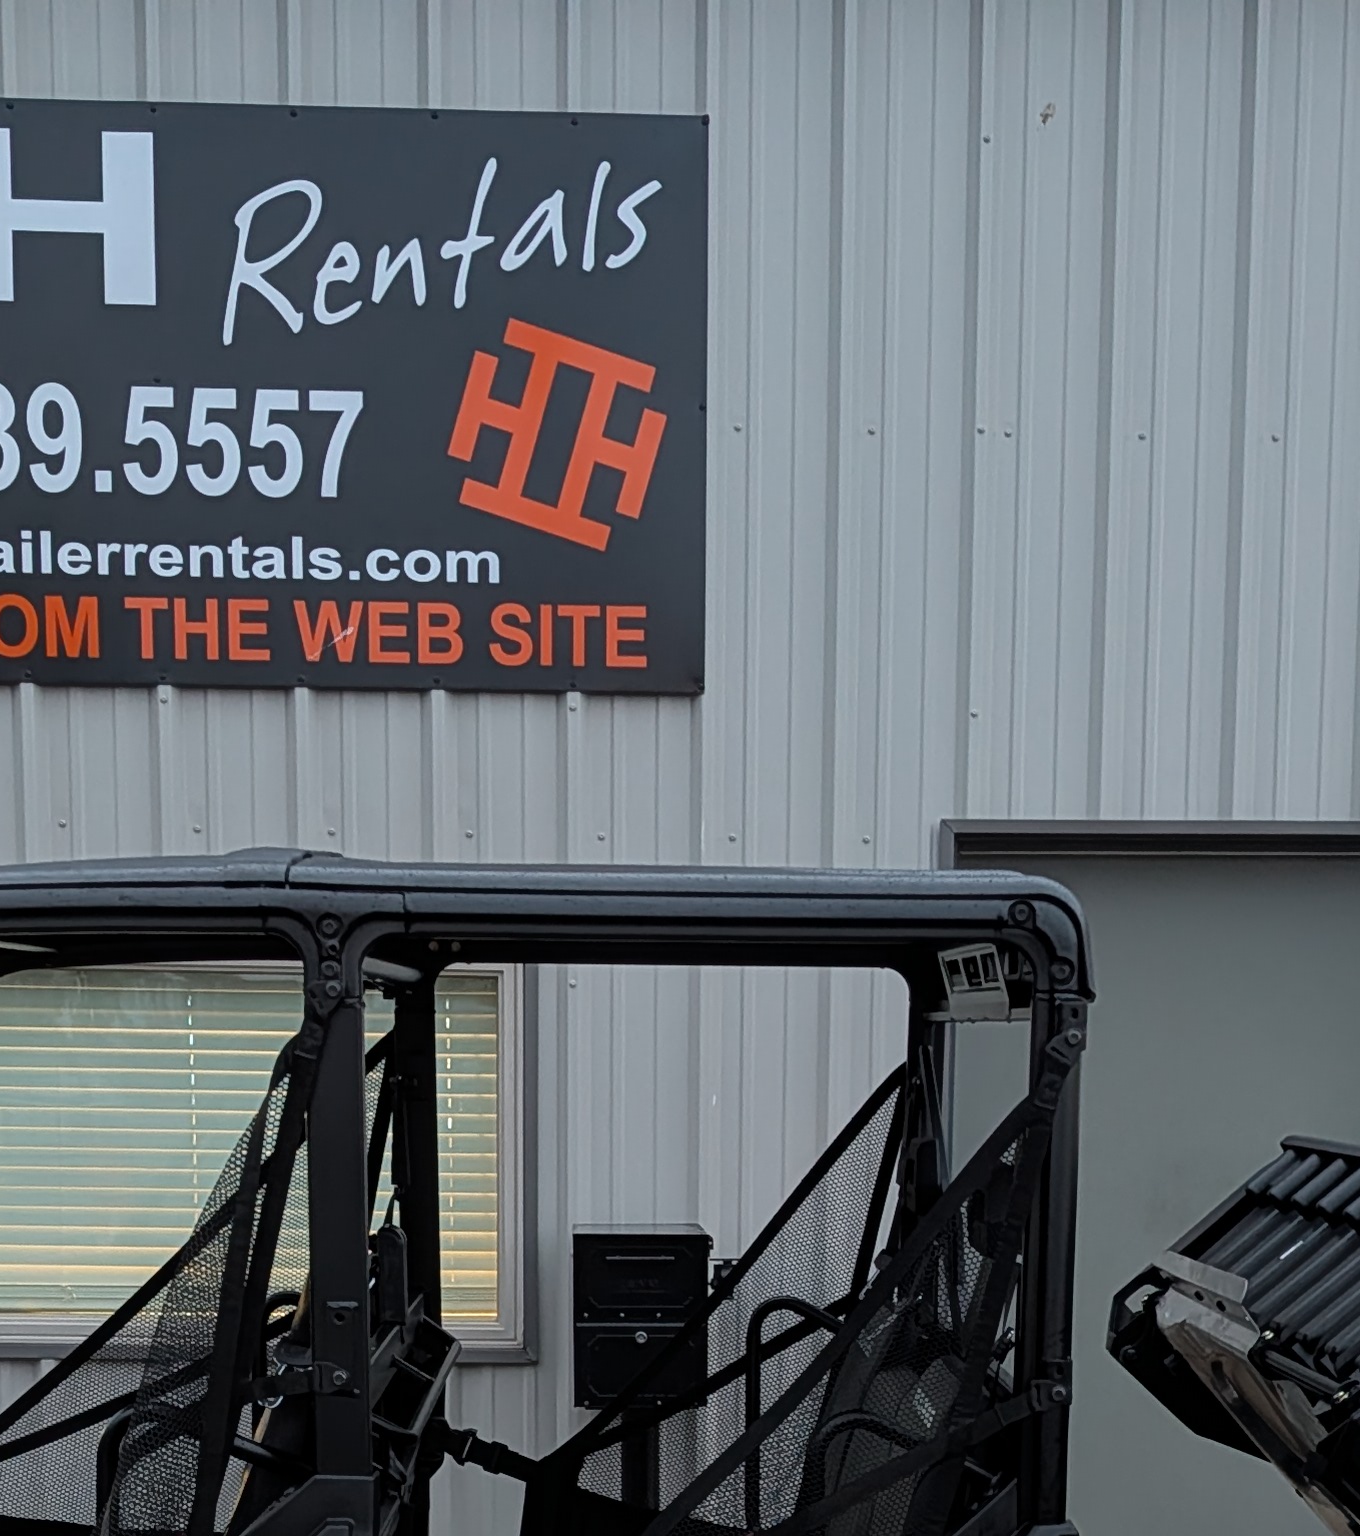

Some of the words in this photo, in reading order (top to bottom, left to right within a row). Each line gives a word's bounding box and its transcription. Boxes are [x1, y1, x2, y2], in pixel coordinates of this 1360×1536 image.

[223, 158, 662, 345] Rentals
[125, 597, 270, 661] THE
[294, 600, 463, 664] WEB
[490, 603, 647, 668] SITE
